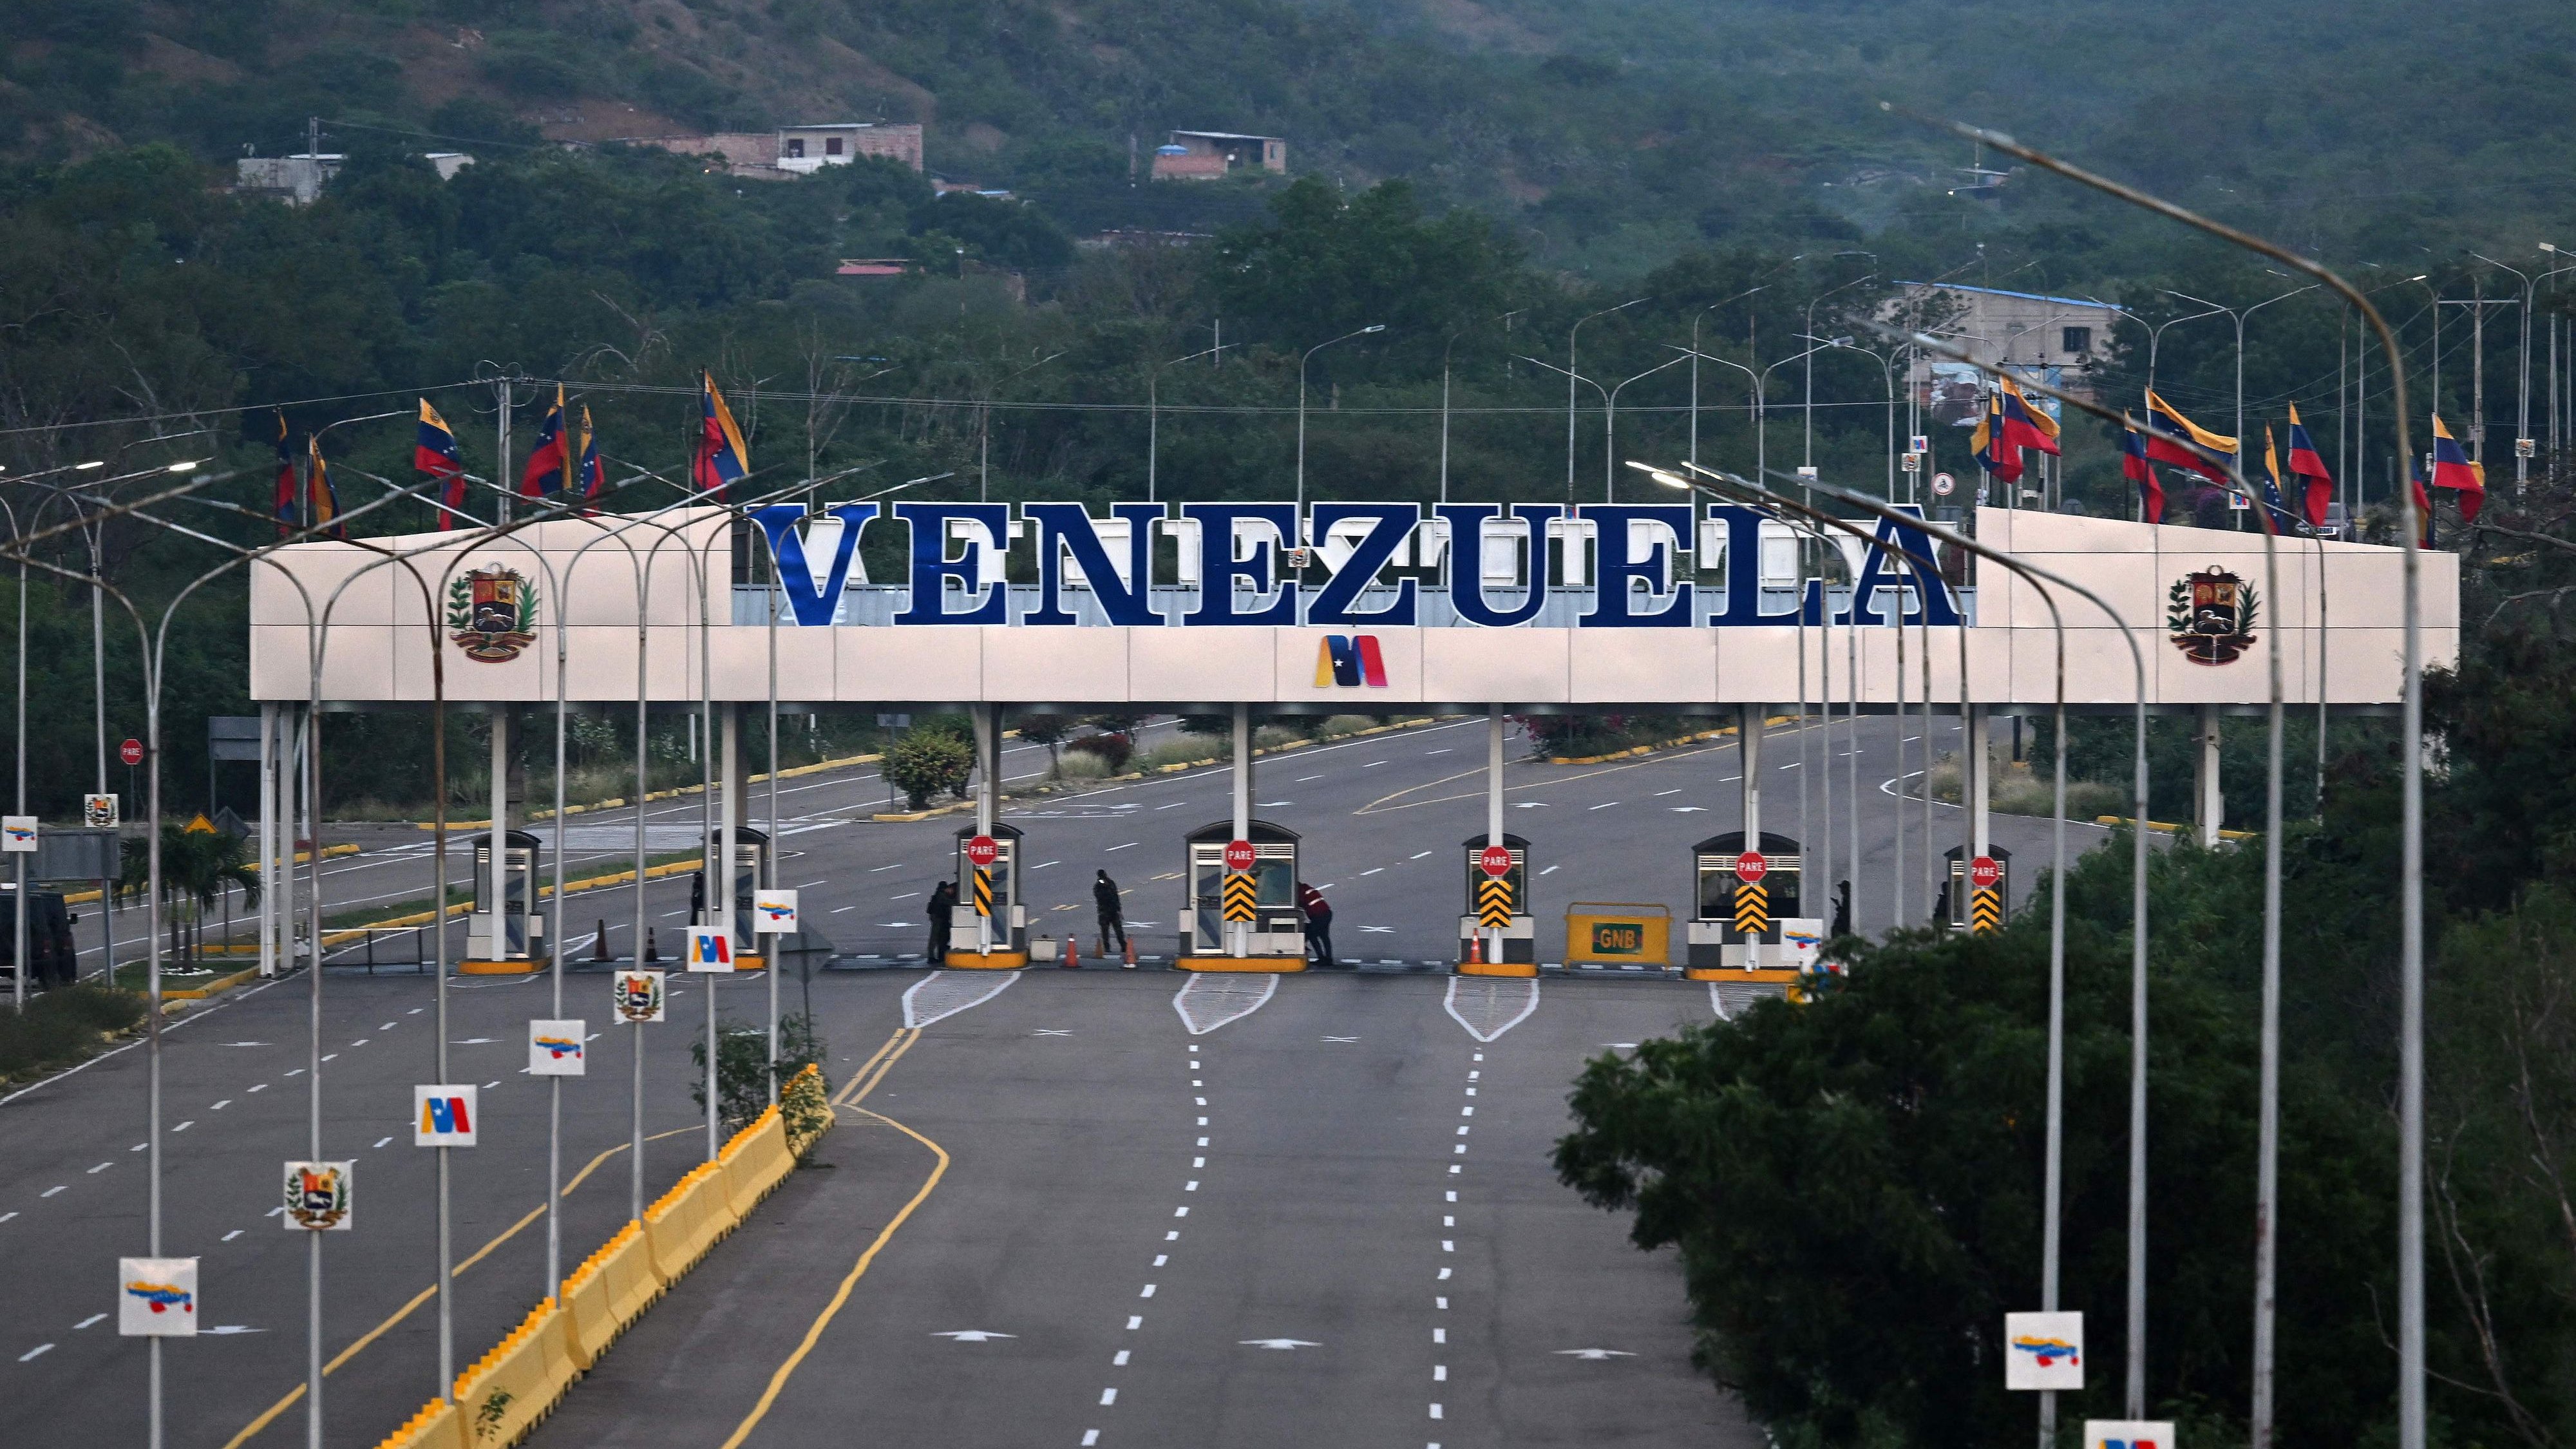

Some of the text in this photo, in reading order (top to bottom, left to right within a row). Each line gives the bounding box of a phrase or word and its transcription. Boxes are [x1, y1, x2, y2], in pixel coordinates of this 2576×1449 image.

[743, 502, 1969, 628] VENEZUELA
[970, 846, 994, 855] PARE
[1227, 850, 1253, 860] PARE
[1483, 856, 1508, 866] PARE
[1739, 862, 1763, 872] PARE
[1971, 867, 1996, 877] PARE
[1600, 929, 1636, 949] GNB
